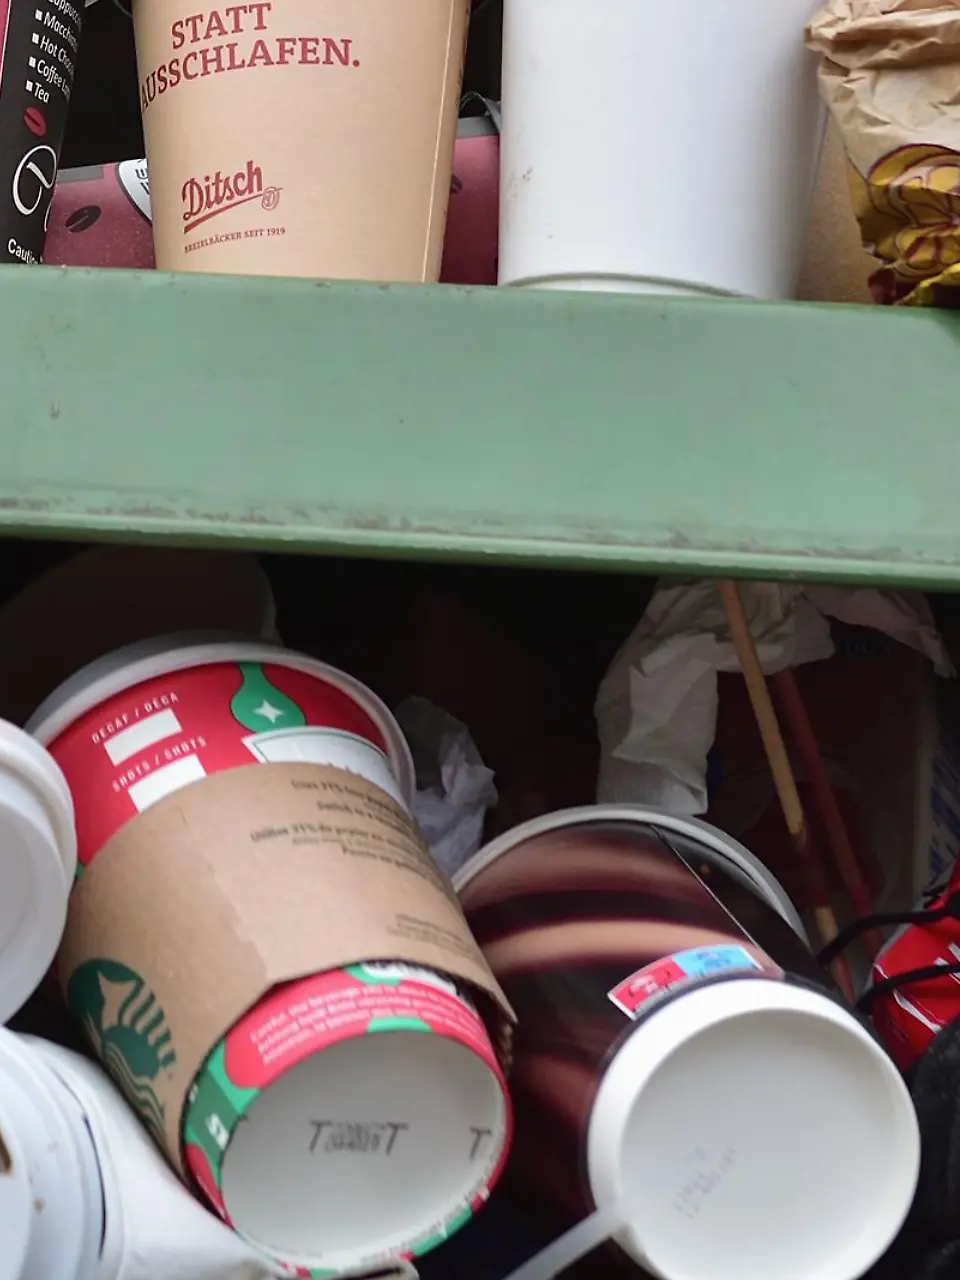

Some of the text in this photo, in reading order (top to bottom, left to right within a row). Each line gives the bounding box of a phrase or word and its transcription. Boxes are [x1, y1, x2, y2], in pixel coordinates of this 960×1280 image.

[171, 2, 271, 49] STATT
[40, 35, 58, 58] Hot
[37, 59, 62, 88] Coffee
[141, 37, 360, 111] AUSSCHLAFEN.
[34, 82, 50, 103] Tea
[182, 160, 263, 221] Ditsch
[244, 228, 264, 239] SEIT
[267, 226, 286, 236] 1919
[92, 713, 128, 744] DECAF
